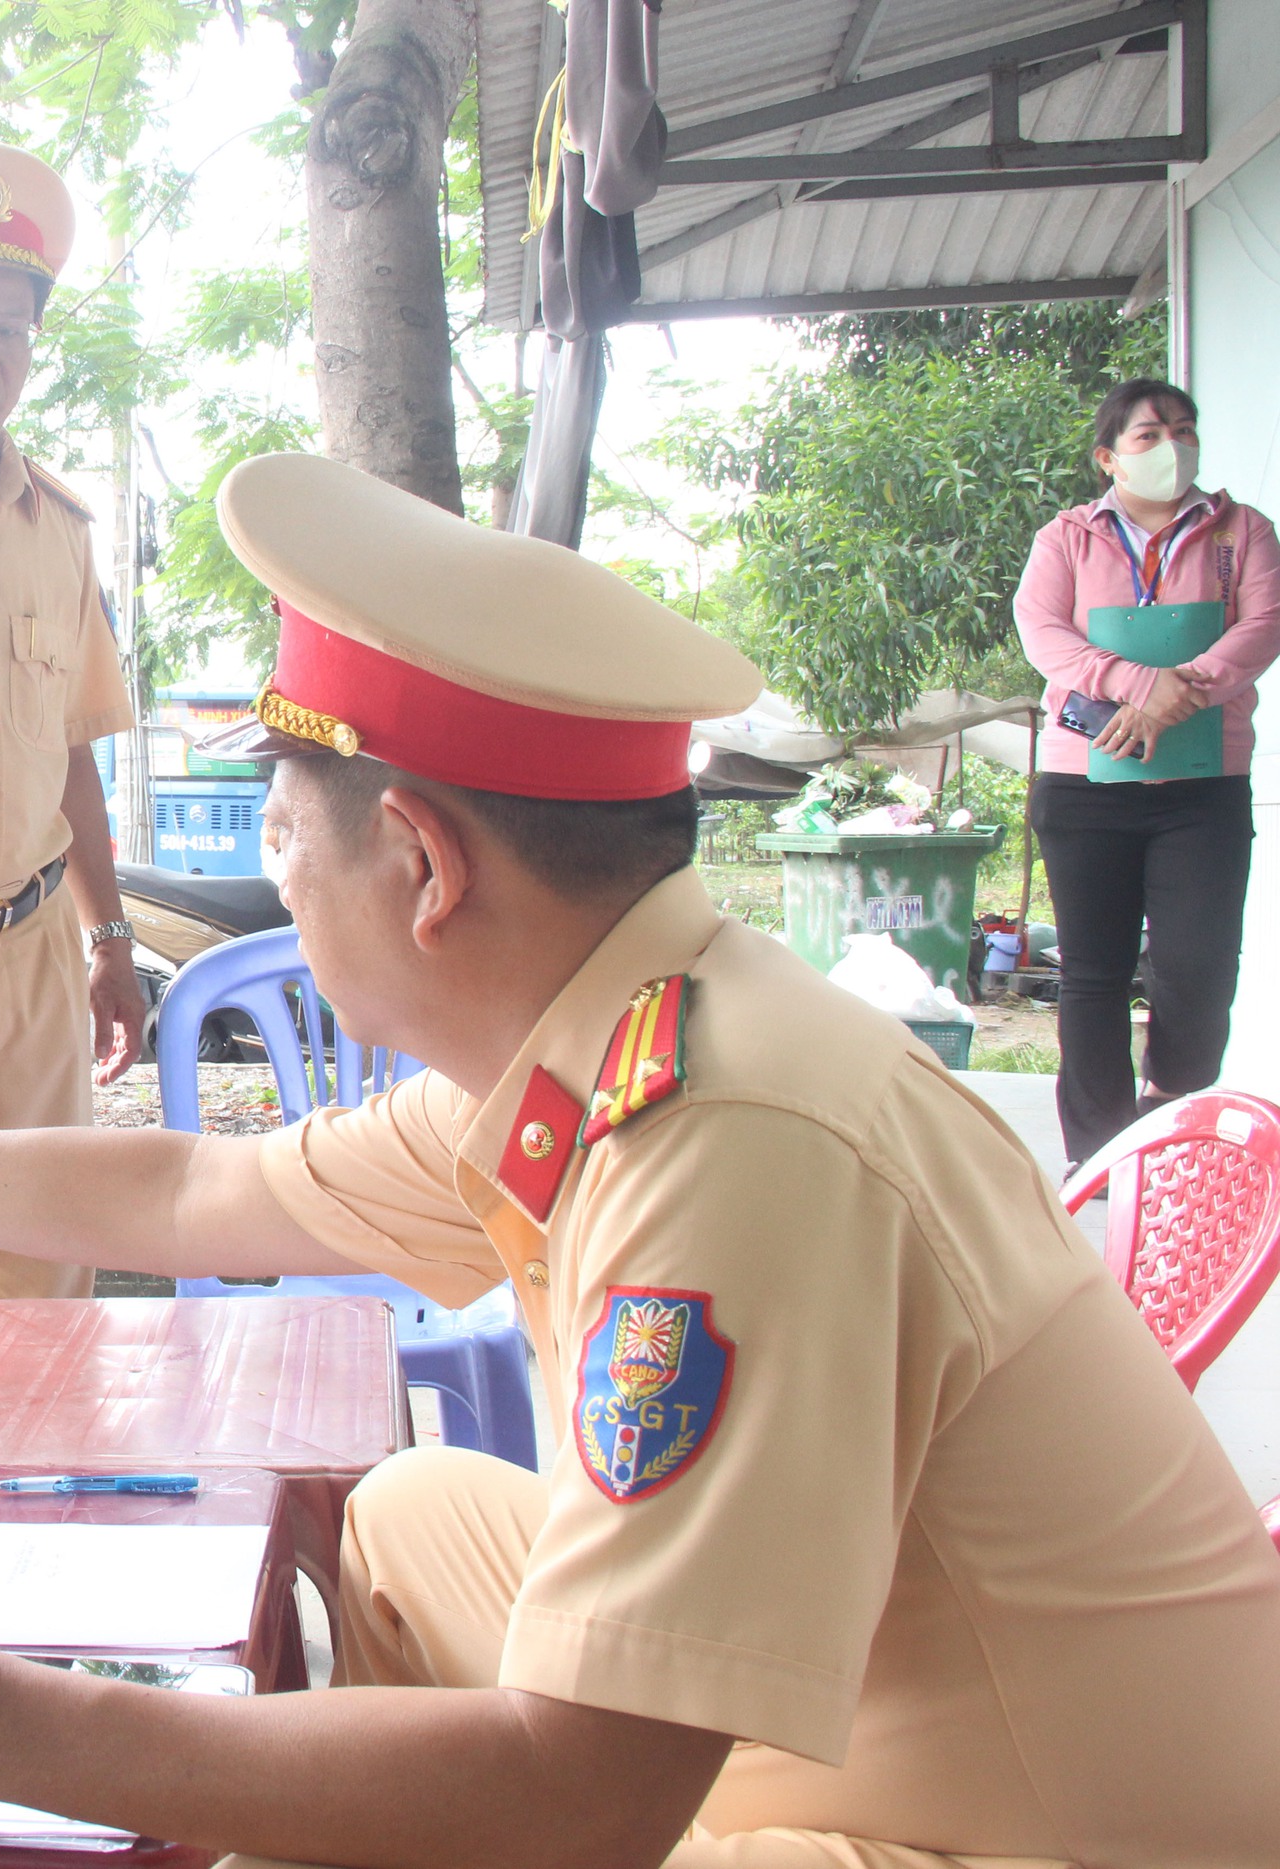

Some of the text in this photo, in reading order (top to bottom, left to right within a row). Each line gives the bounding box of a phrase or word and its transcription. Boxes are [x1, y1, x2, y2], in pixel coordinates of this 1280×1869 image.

[1222, 546, 1233, 606] Westcoast
[198, 711, 228, 723] MINH
[621, 1365, 658, 1380] CAND
[585, 1396, 698, 1431] CSGT
